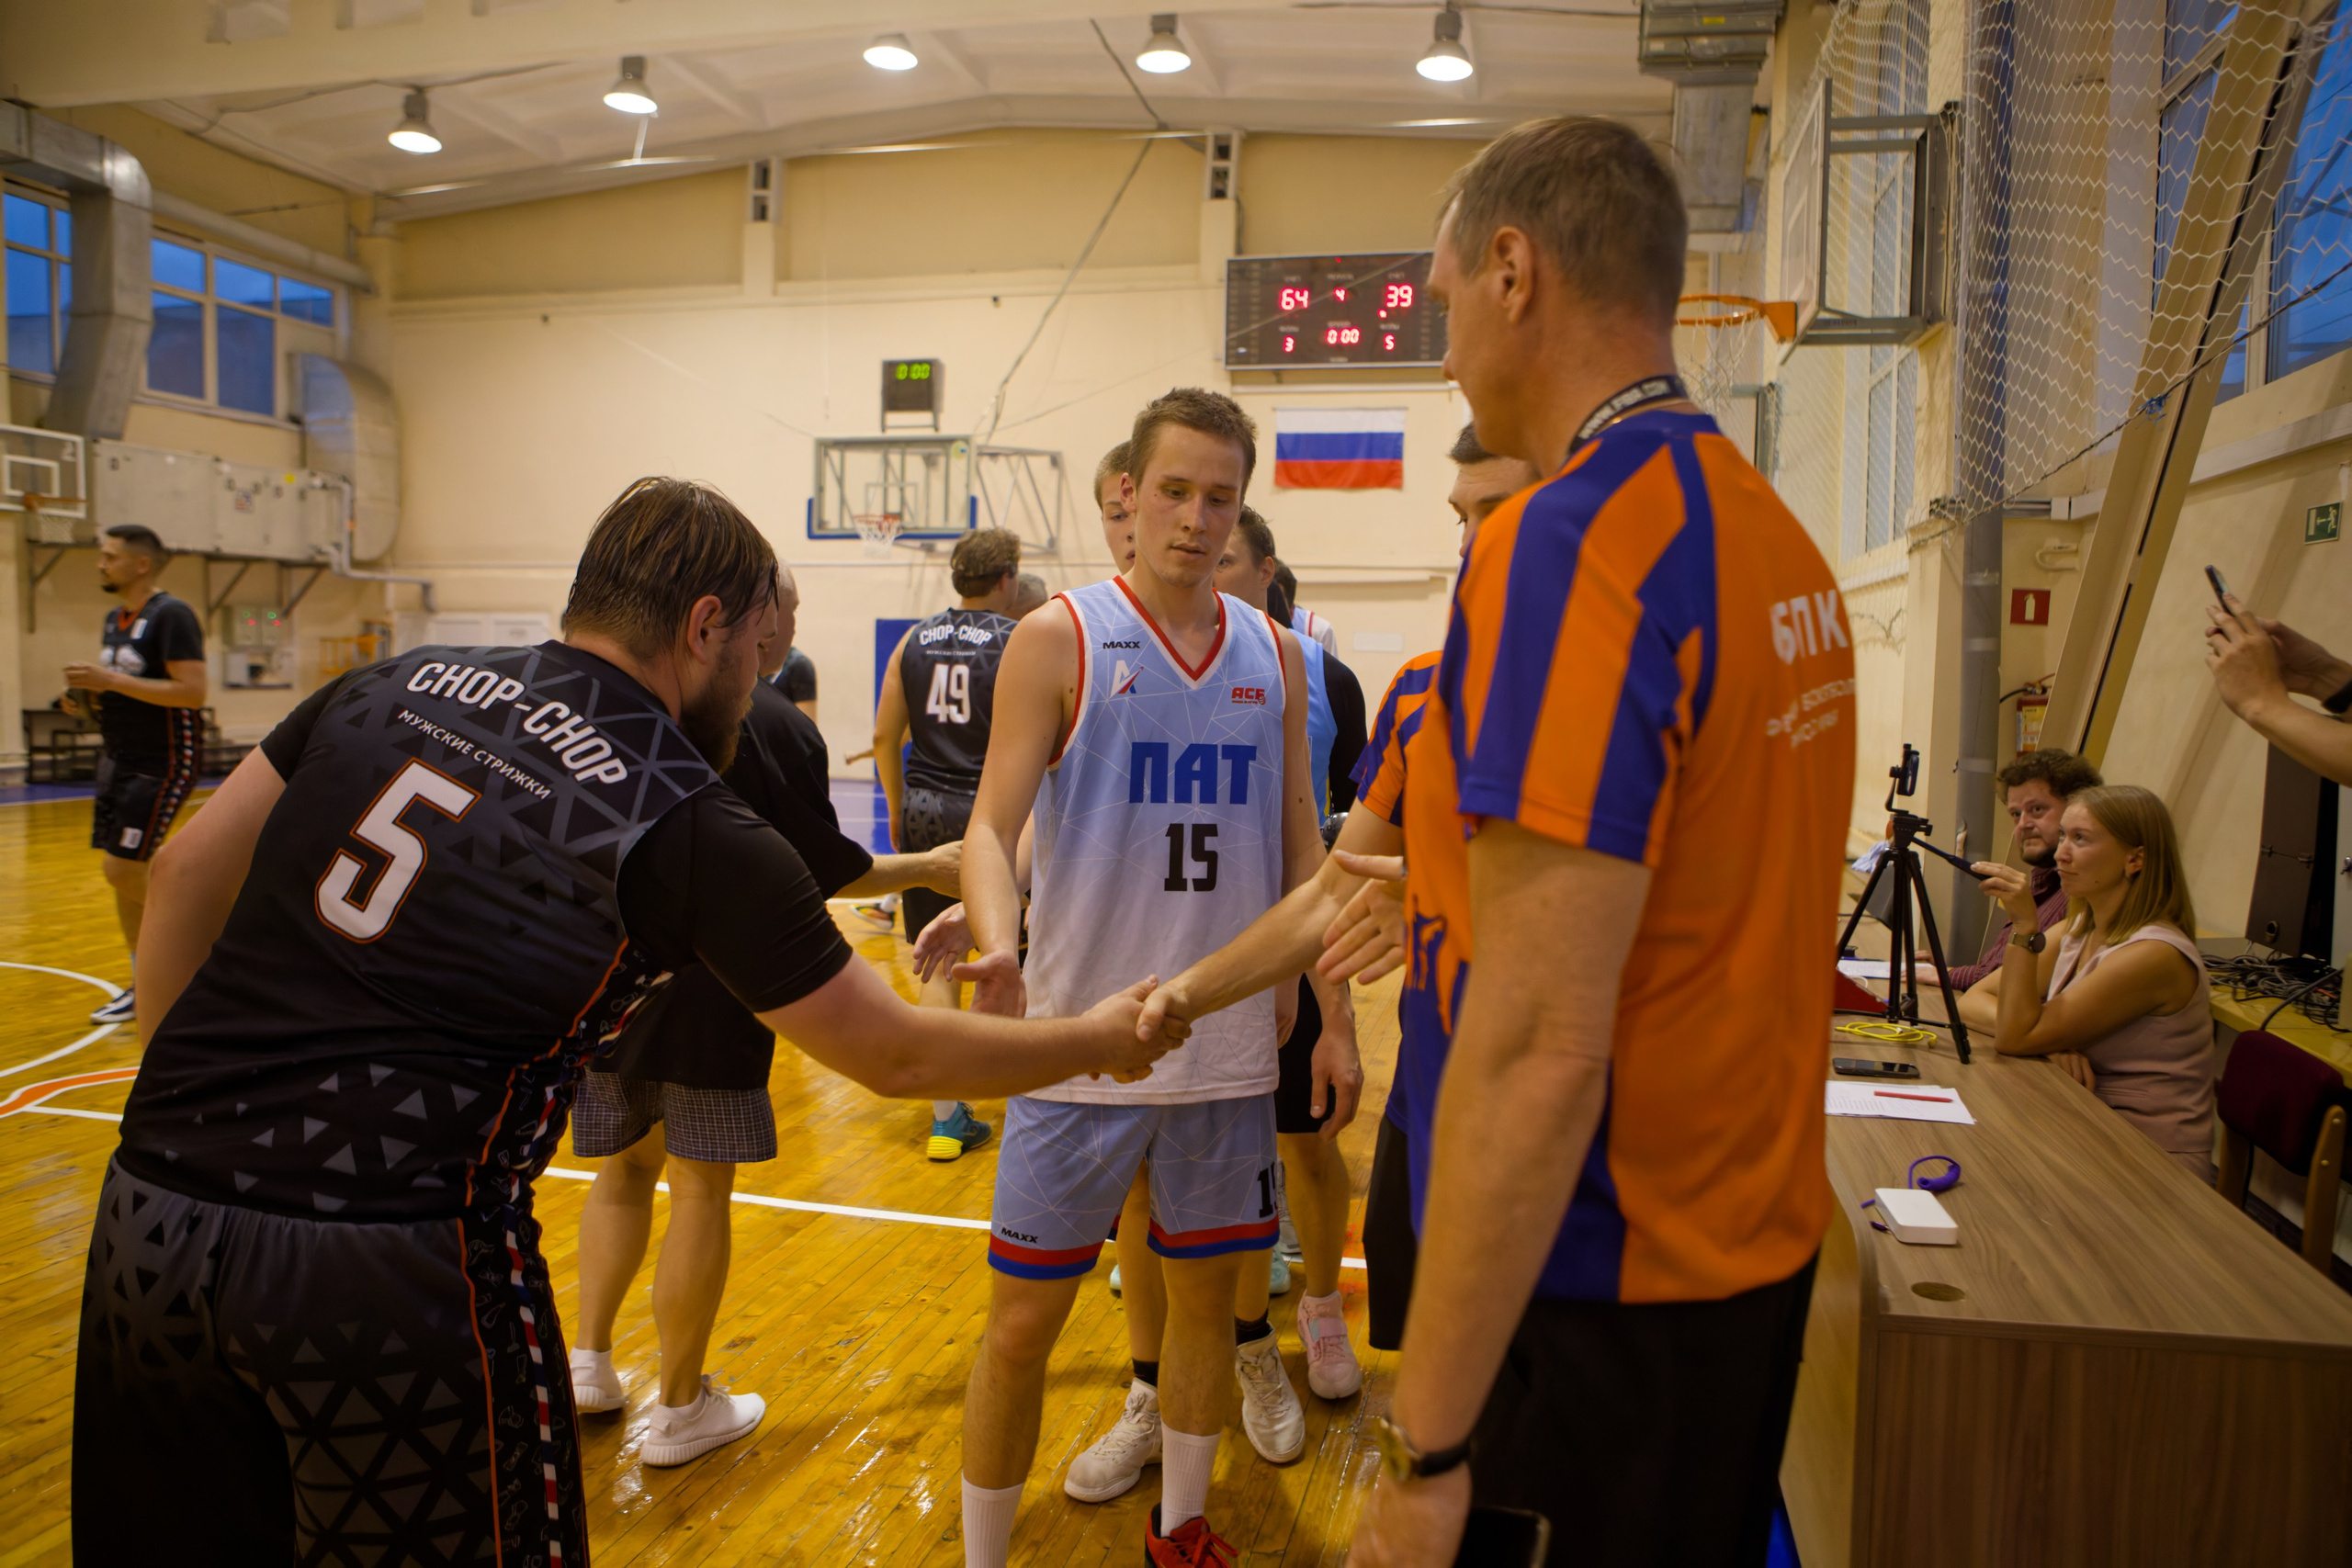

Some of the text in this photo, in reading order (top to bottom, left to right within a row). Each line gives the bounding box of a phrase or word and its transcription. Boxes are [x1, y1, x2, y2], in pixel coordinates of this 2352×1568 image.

[1280, 288, 1309, 310] 64
[1385, 284, 1413, 308] 39
[1283, 336, 1295, 353] 3
[1384, 334, 1395, 351] 5
[920, 625, 993, 646] CHOP-CHOP
[1102, 641, 1141, 649] MAXX
[1769, 589, 1849, 666] БПК
[926, 662, 971, 724] 49
[406, 662, 628, 785] CHOP-CHOP
[399, 709, 551, 800] МУЖСКИЕ СТРИЖКИ
[1129, 741, 1258, 806] ПАТ
[314, 757, 483, 944] 5
[1164, 823, 1219, 892] 15
[1257, 1161, 1277, 1219] 1
[1001, 1227, 1039, 1245] MAXX
